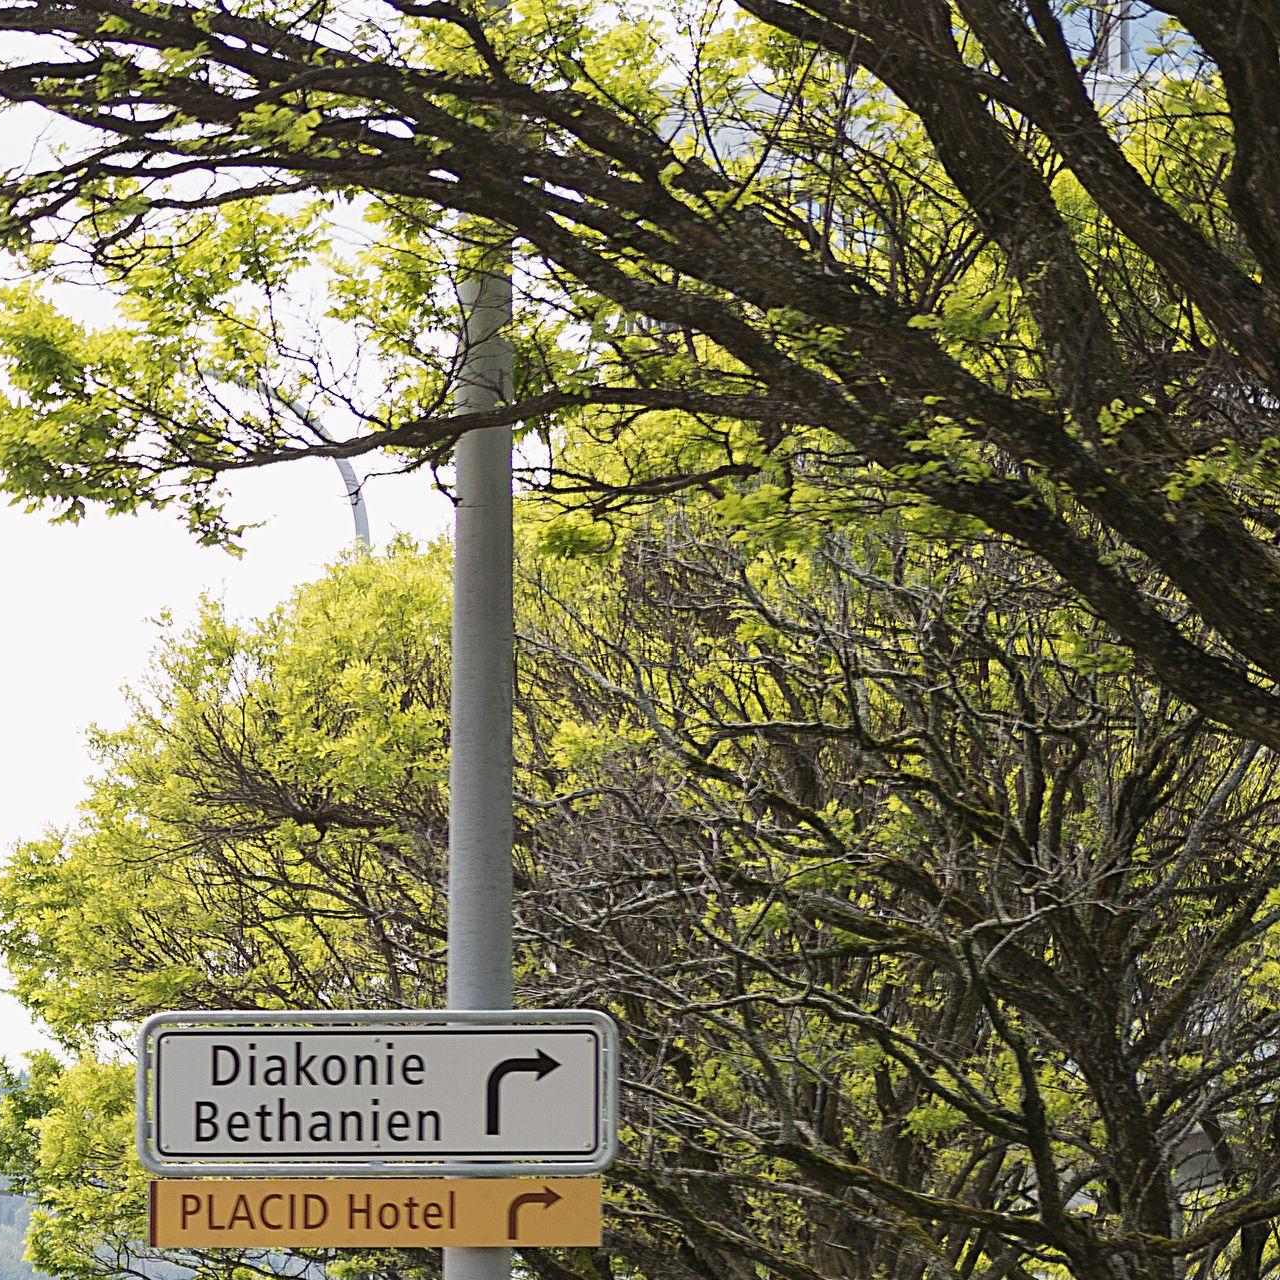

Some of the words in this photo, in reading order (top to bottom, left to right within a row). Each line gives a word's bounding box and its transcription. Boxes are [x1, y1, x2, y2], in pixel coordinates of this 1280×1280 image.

[212, 1040, 426, 1086] Diakonie
[195, 1098, 441, 1142] Bethanien
[181, 1193, 329, 1230] PLACID
[348, 1190, 456, 1230] Hotel
